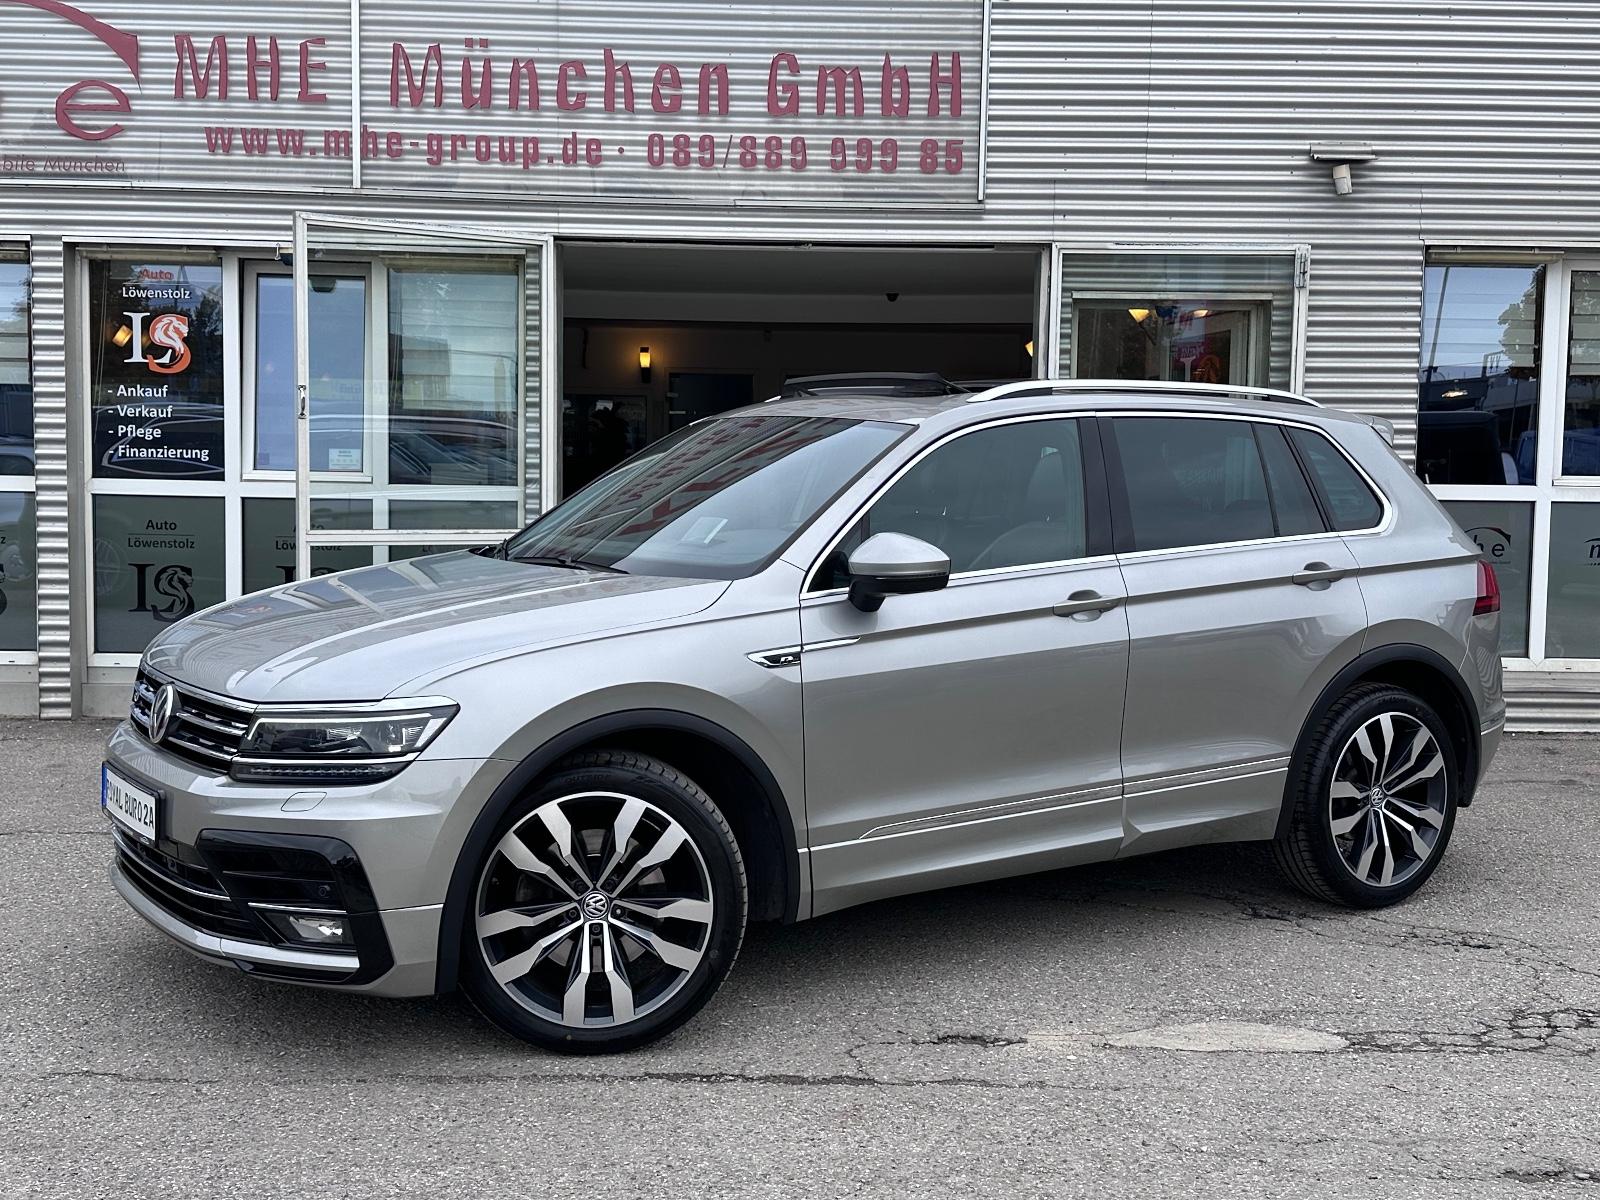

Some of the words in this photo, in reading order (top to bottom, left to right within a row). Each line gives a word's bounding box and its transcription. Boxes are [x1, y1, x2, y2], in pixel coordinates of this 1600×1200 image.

[174, 35, 327, 101] MHE
[389, 37, 730, 115] München
[767, 51, 963, 118] GmbH
[204, 125, 602, 168] www.mhe-group.de
[646, 133, 808, 170] 089/889
[829, 138, 900, 173] 999
[918, 138, 965, 174] 85
[43, 155, 126, 173] München
[139, 268, 174, 282] Auto
[121, 287, 192, 300] Löwenstolz
[116, 385, 169, 398] Ankauf
[116, 405, 173, 418] Verkauf
[117, 425, 162, 441] Pflege
[117, 445, 210, 462] Finanzierung
[146, 519, 178, 532] Auto
[127, 537, 196, 550] Löwenstolz
